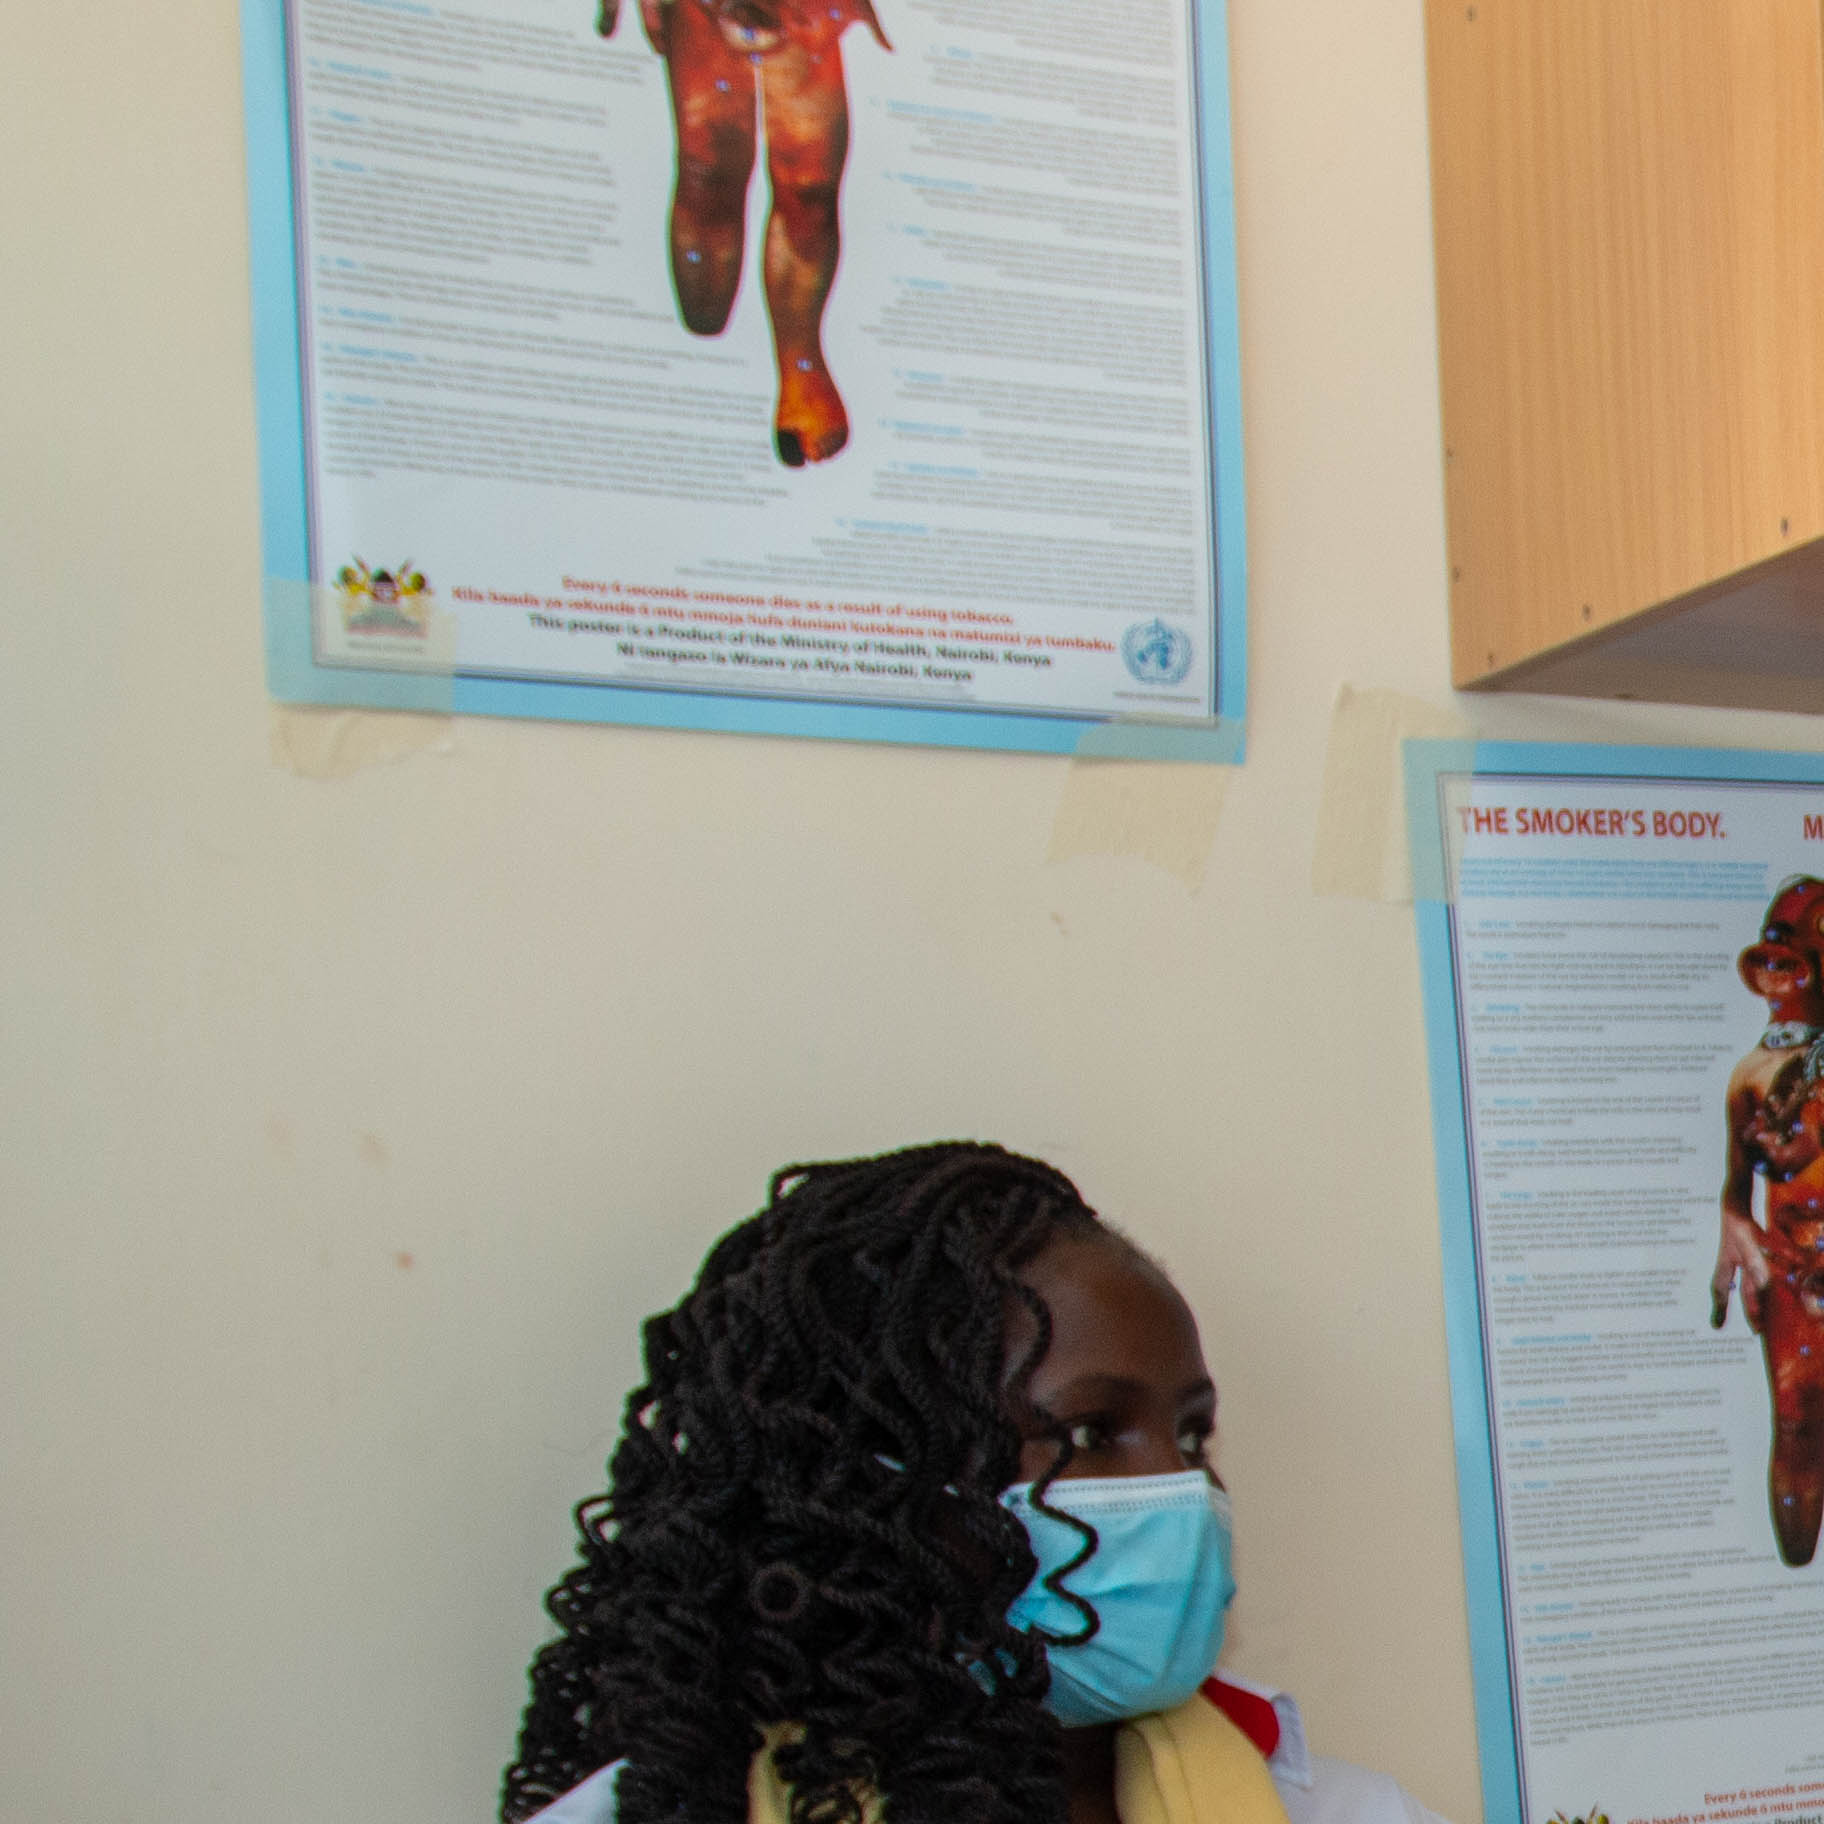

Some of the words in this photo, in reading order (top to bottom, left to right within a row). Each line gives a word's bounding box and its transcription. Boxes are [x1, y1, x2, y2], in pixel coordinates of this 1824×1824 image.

[1459, 806, 1509, 834] THE
[1515, 807, 1645, 837] SMOKER'S
[1653, 810, 1727, 839] BODY.
[1704, 1790, 1736, 1806] Every
[1739, 1789, 1746, 1800] 6
[1749, 1783, 1794, 1799] seconds
